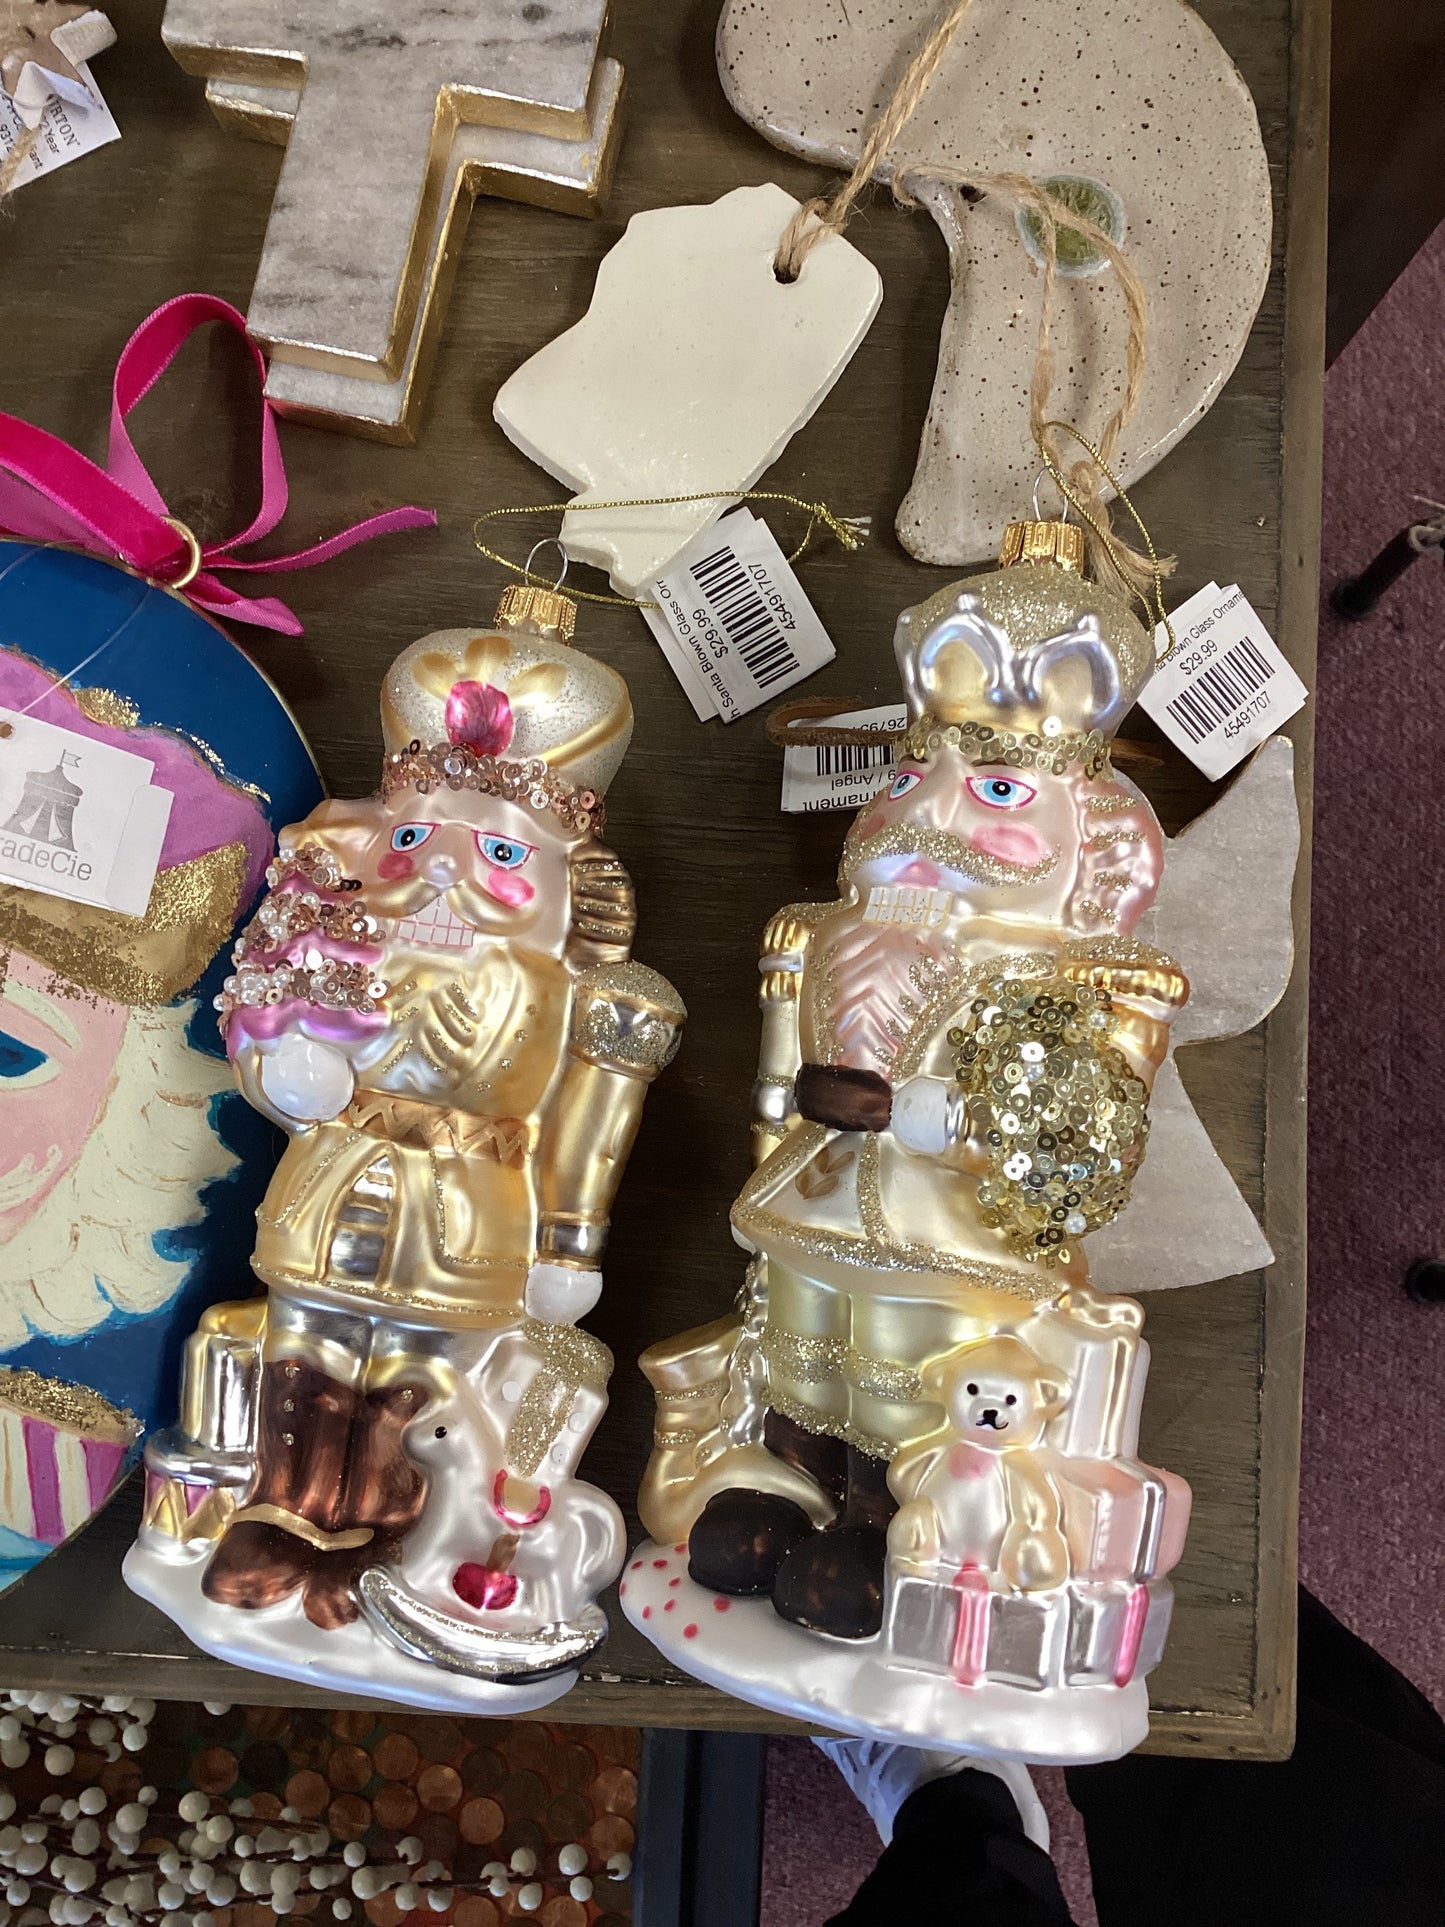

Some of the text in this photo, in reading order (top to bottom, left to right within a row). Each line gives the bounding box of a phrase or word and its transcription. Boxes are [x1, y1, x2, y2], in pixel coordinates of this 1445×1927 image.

[44, 128, 60, 154] Year
[748, 563, 796, 631] 45491707
[669, 600, 692, 636] Glass
[692, 608, 729, 659] $29.99
[1189, 617, 1216, 639] Glass
[689, 635, 714, 674] Blown
[1179, 639, 1219, 676] $29.99
[710, 672, 734, 708] Santa
[1223, 690, 1272, 740] 45491707
[831, 773, 875, 791] Angel
[803, 791, 876, 813] rnament
[0, 837, 93, 882] adeCie
